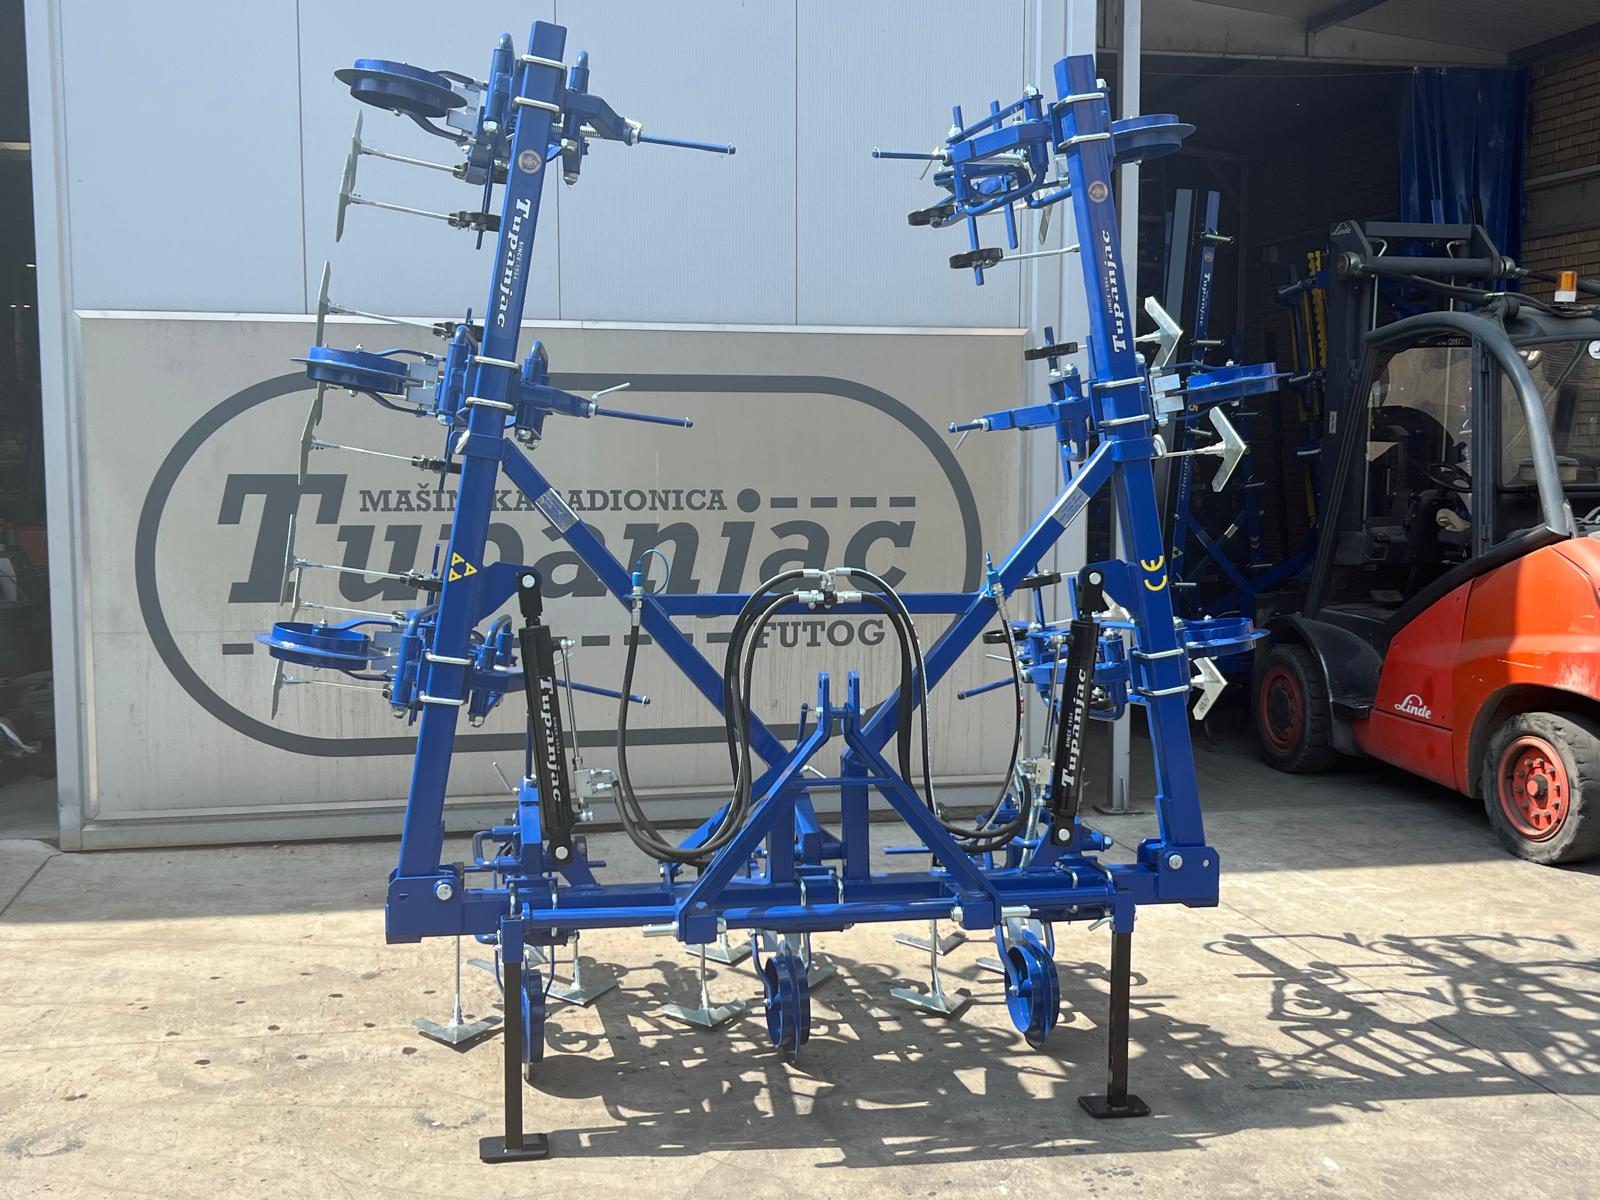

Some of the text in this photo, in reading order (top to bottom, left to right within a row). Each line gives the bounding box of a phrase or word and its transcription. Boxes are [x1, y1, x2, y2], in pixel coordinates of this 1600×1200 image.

[497, 198, 531, 328] Tupanjac
[1101, 230, 1127, 353] Tupanjac
[359, 482, 536, 512] MAŠIKA
[553, 488, 728, 512] ADIONICA
[753, 619, 886, 649] FUTOG
[540, 676, 561, 802] Tupanjac
[1061, 668, 1086, 788] Tupanjac
[1394, 693, 1432, 719] Linde
